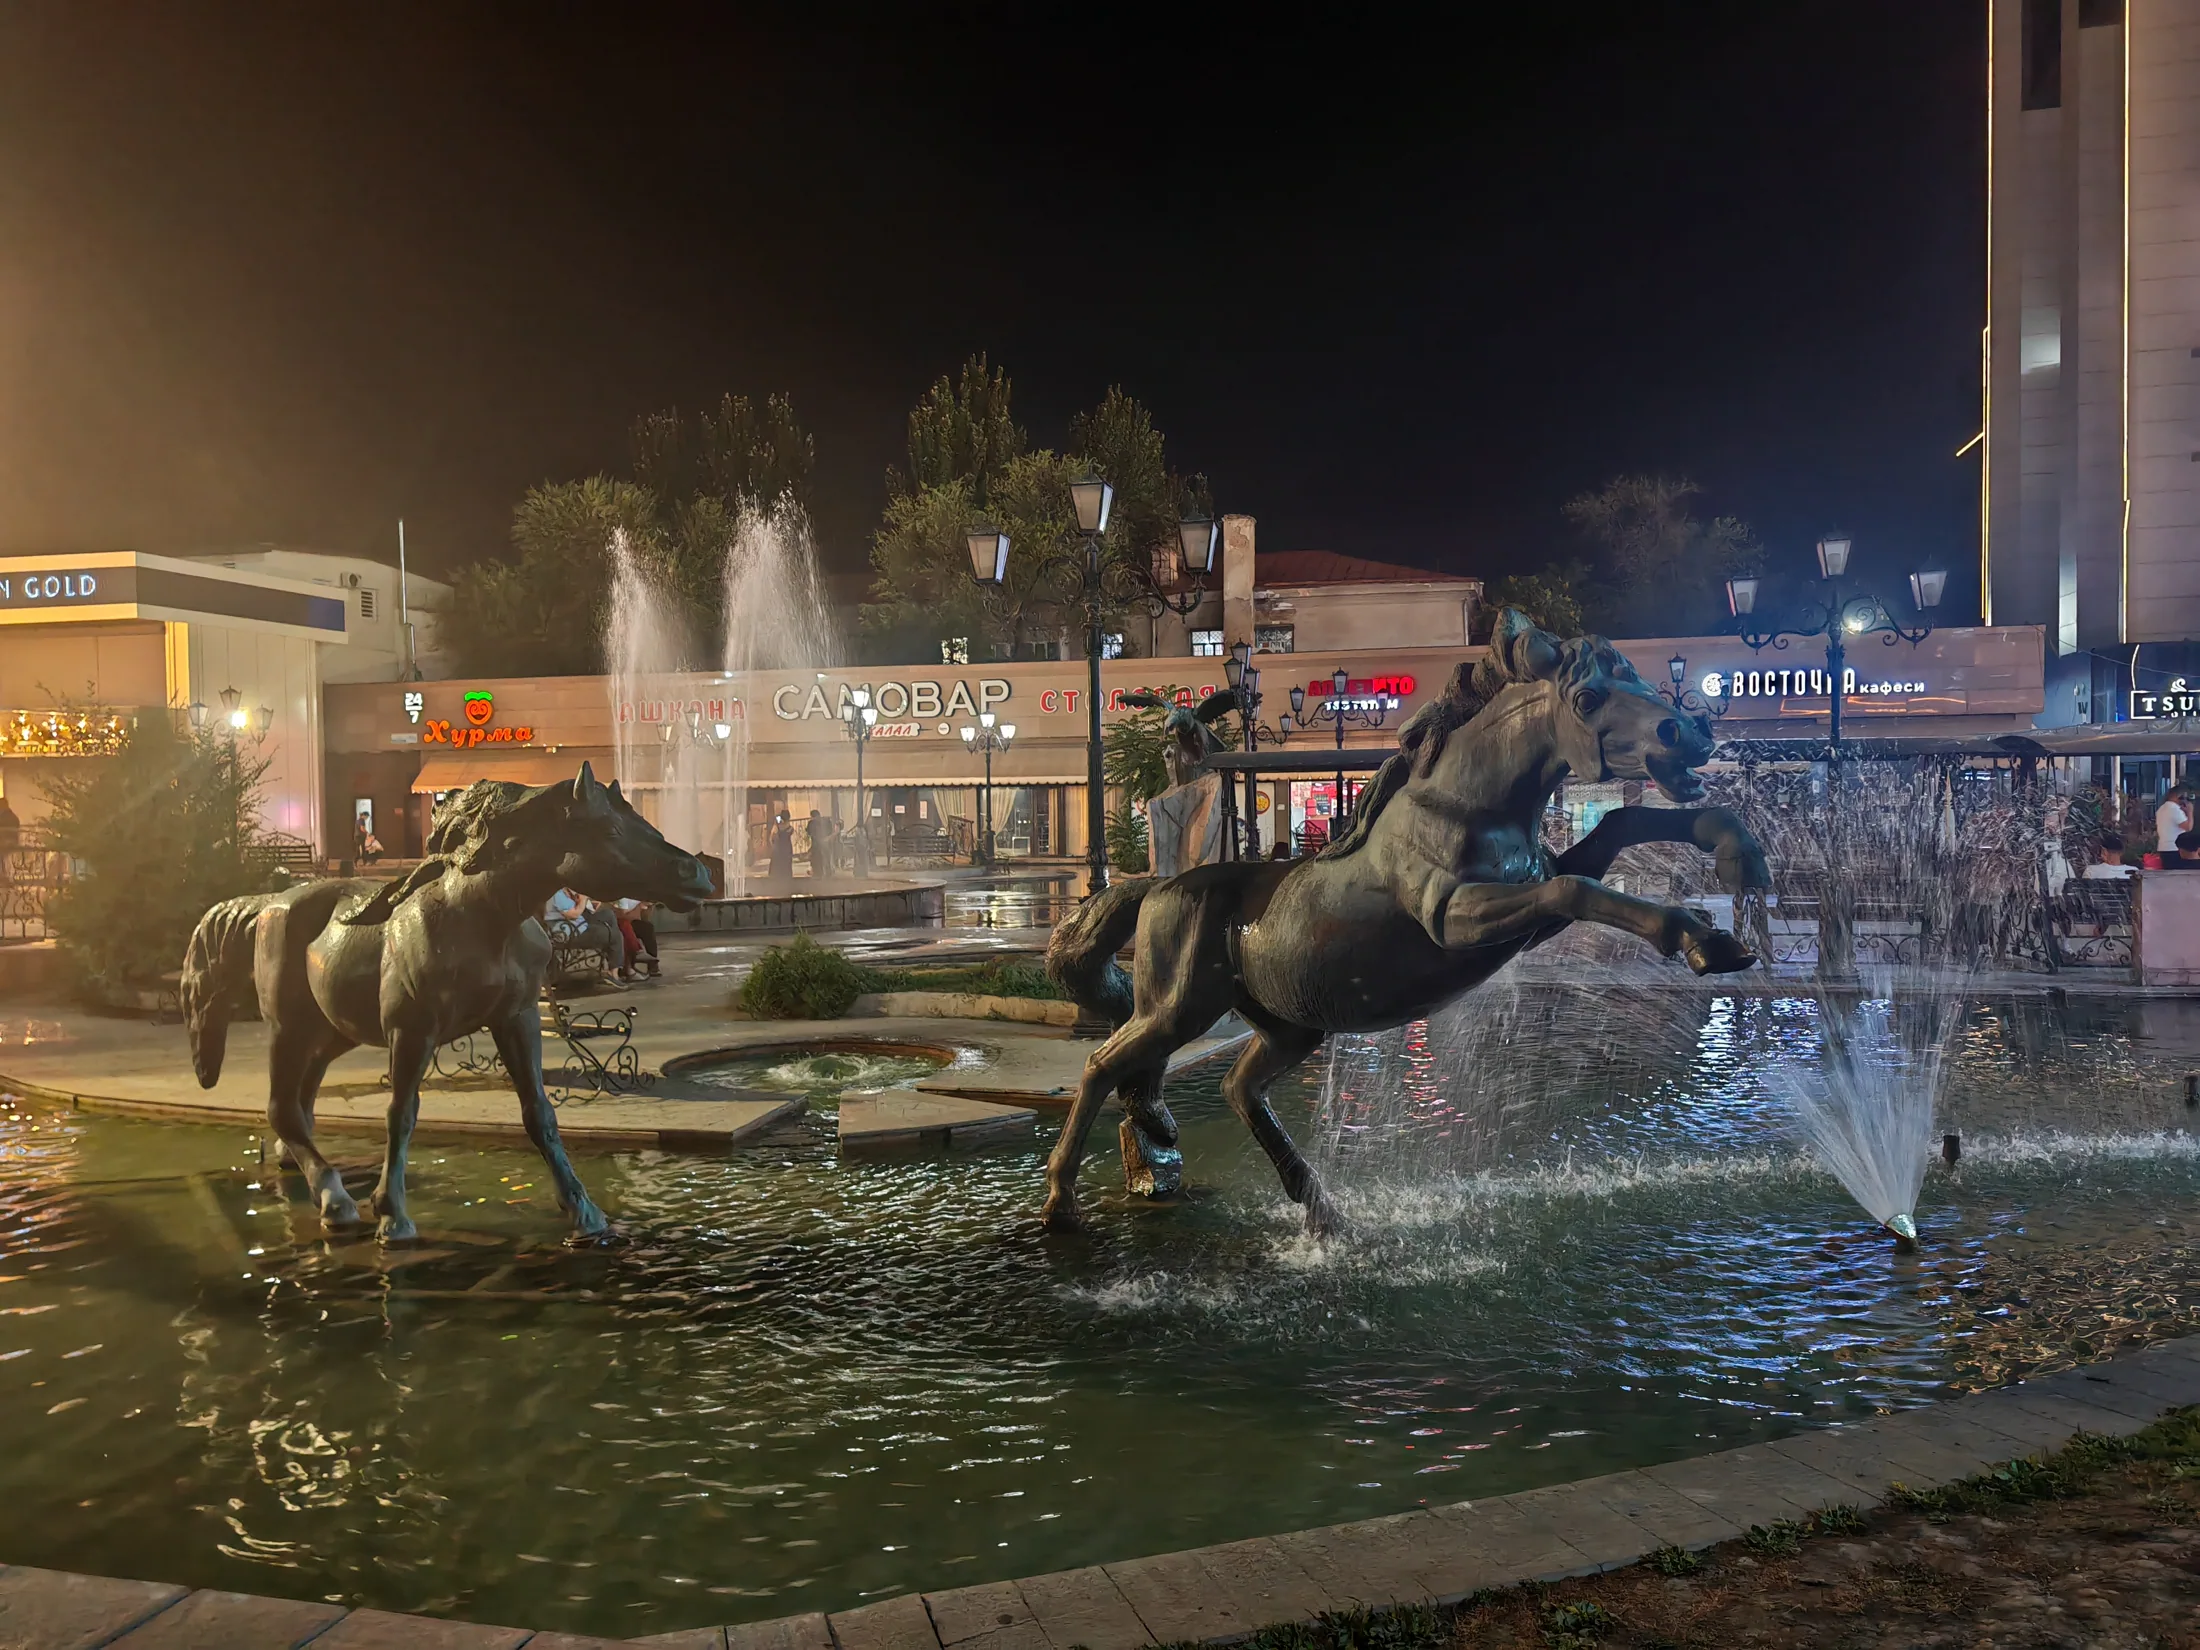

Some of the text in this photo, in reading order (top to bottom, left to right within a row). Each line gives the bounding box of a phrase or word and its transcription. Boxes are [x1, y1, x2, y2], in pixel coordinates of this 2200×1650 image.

[24, 575, 96, 599] GOLD
[1308, 677, 1414, 696] АПЕТИТО
[1732, 668, 1925, 697] ВОСТОЧА кафеси
[405, 692, 423, 706] 24
[1351, 699, 1399, 711] ТАТМ
[2142, 696, 2200, 711] TSU
[410, 710, 419, 724] 7
[423, 720, 534, 748] Хурма
